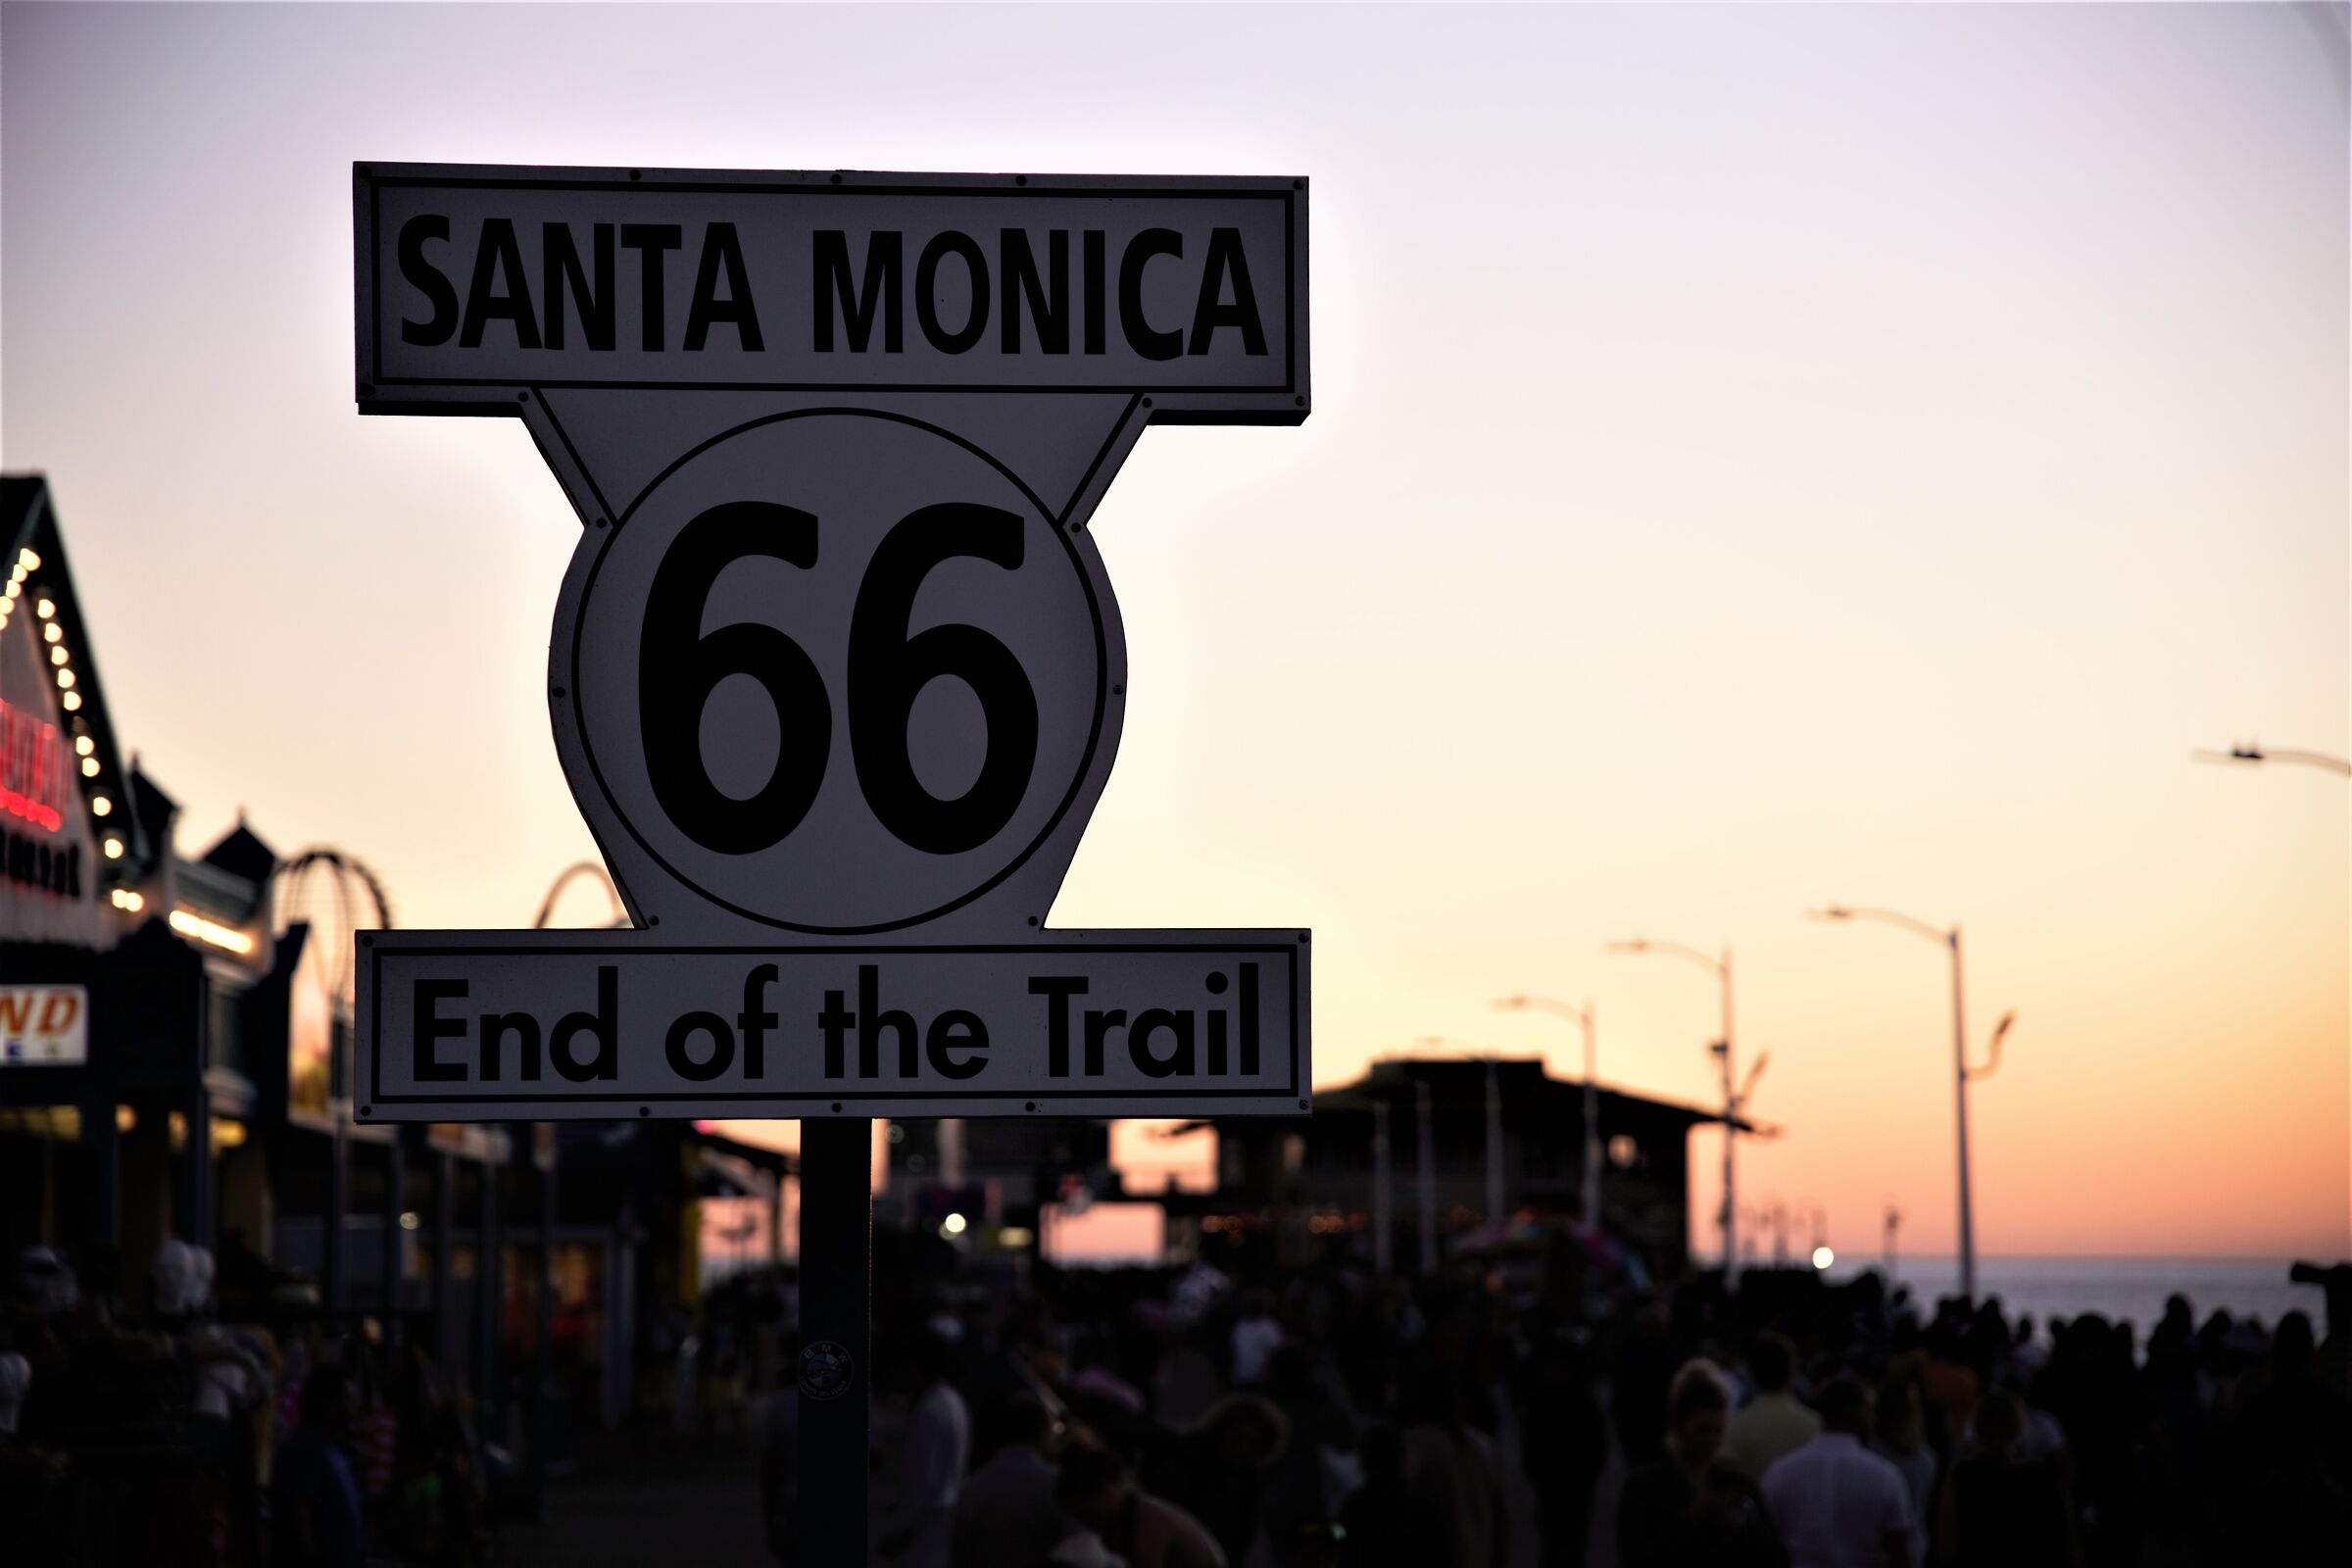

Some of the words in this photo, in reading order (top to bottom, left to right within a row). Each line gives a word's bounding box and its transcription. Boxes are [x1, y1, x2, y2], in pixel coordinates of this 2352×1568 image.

[398, 215, 764, 352] SANTA
[813, 227, 1268, 361] MONICA
[638, 500, 1039, 856] 66
[414, 965, 618, 1082] End
[665, 964, 778, 1081] of
[818, 965, 989, 1079] the
[1028, 962, 1259, 1078] Trail
